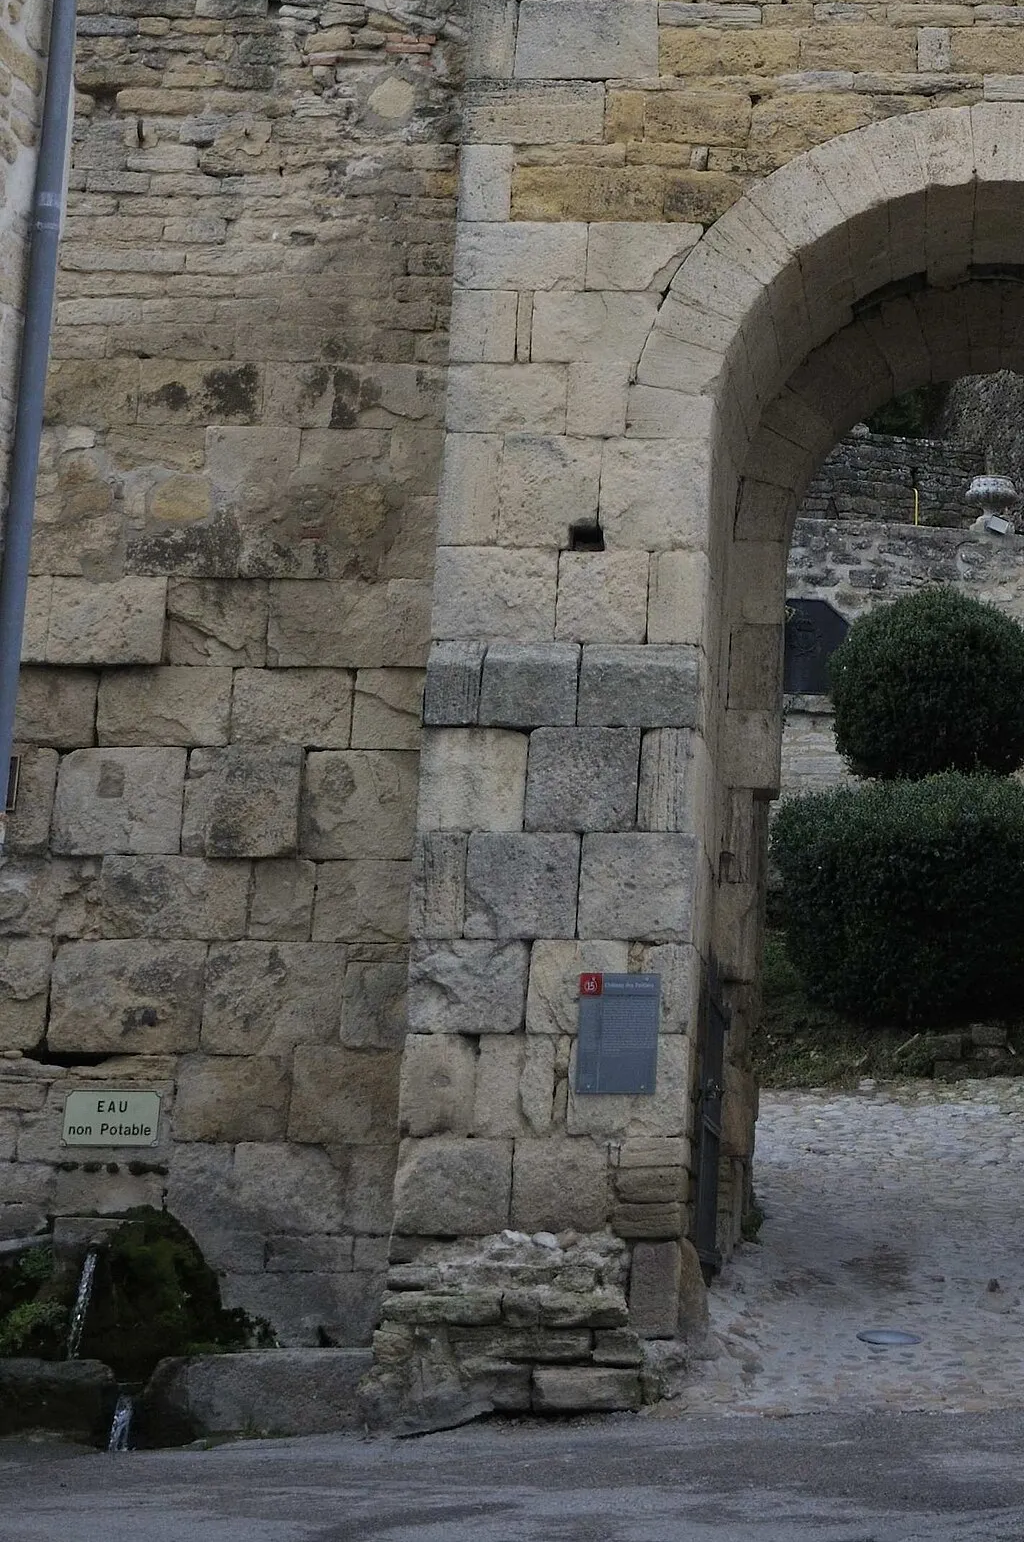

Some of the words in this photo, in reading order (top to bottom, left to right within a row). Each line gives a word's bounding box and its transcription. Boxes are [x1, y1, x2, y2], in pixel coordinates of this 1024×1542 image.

[97, 1100, 128, 1113] EAU
[68, 1125, 92, 1136] non
[100, 1123, 151, 1136] Potable
